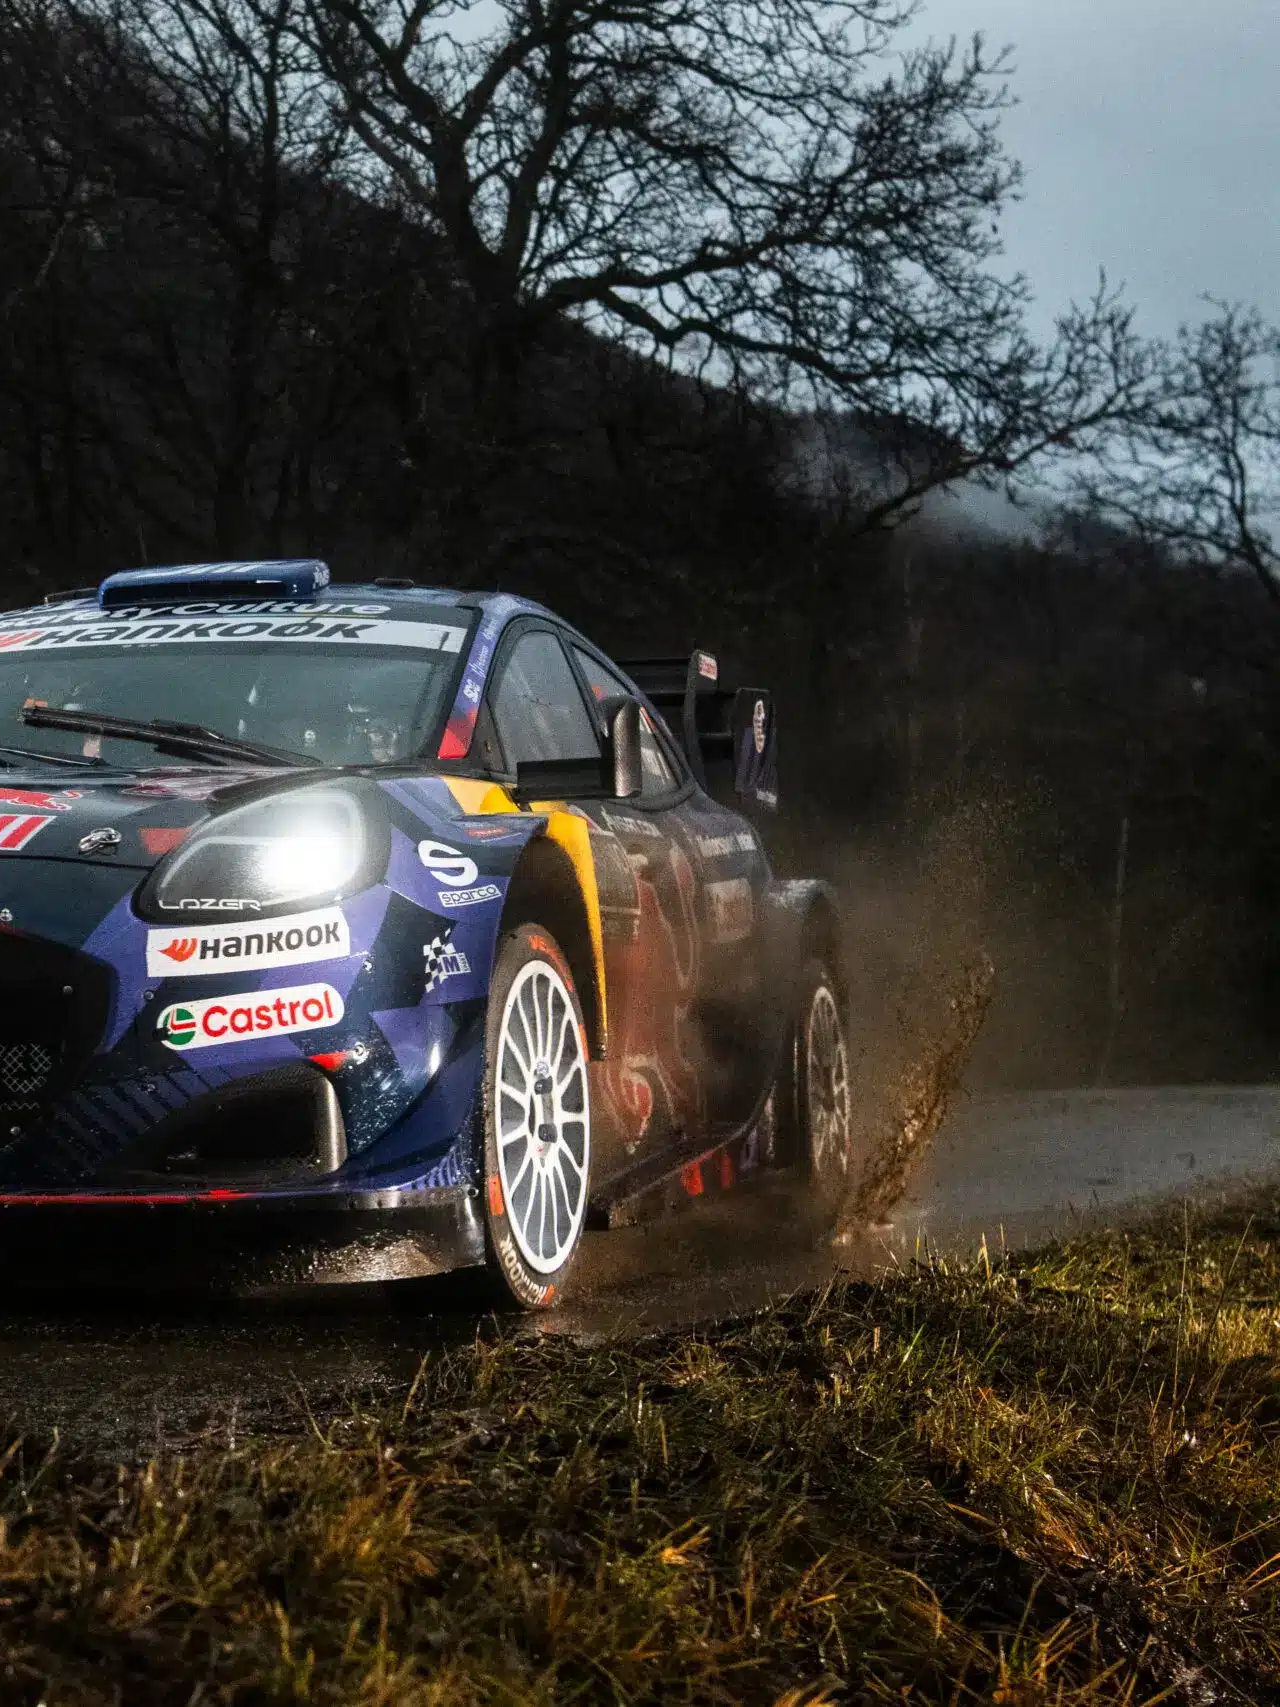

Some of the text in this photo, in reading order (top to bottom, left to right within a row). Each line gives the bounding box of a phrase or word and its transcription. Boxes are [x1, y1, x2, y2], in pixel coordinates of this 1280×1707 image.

[158, 898, 262, 912] LAZER
[441, 886, 497, 905] sparco
[202, 989, 334, 1038] Castrol
